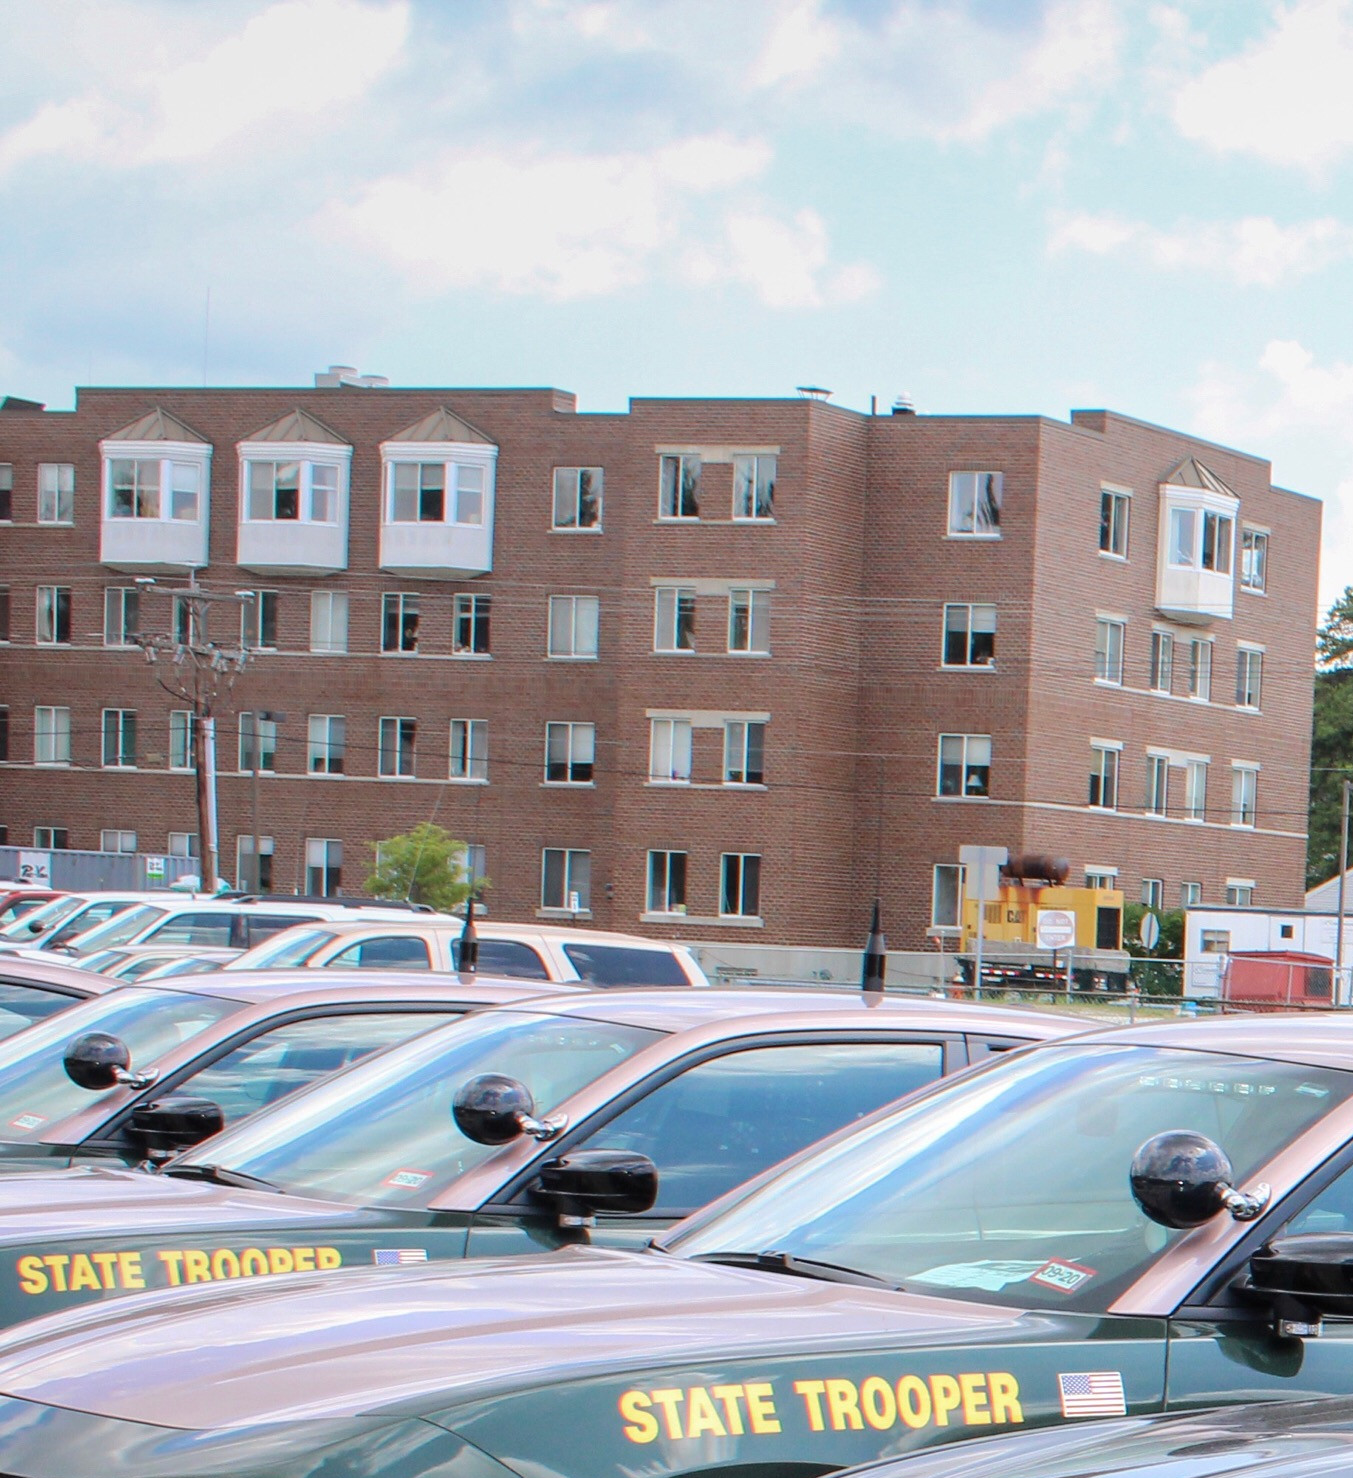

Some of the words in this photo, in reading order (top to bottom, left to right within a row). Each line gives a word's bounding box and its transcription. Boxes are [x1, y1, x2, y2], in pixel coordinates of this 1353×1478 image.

[17, 1254, 146, 1294] STATE
[159, 1247, 342, 1286] TROOPER
[619, 1382, 782, 1443] STATE
[793, 1372, 1025, 1431] TROOPER
